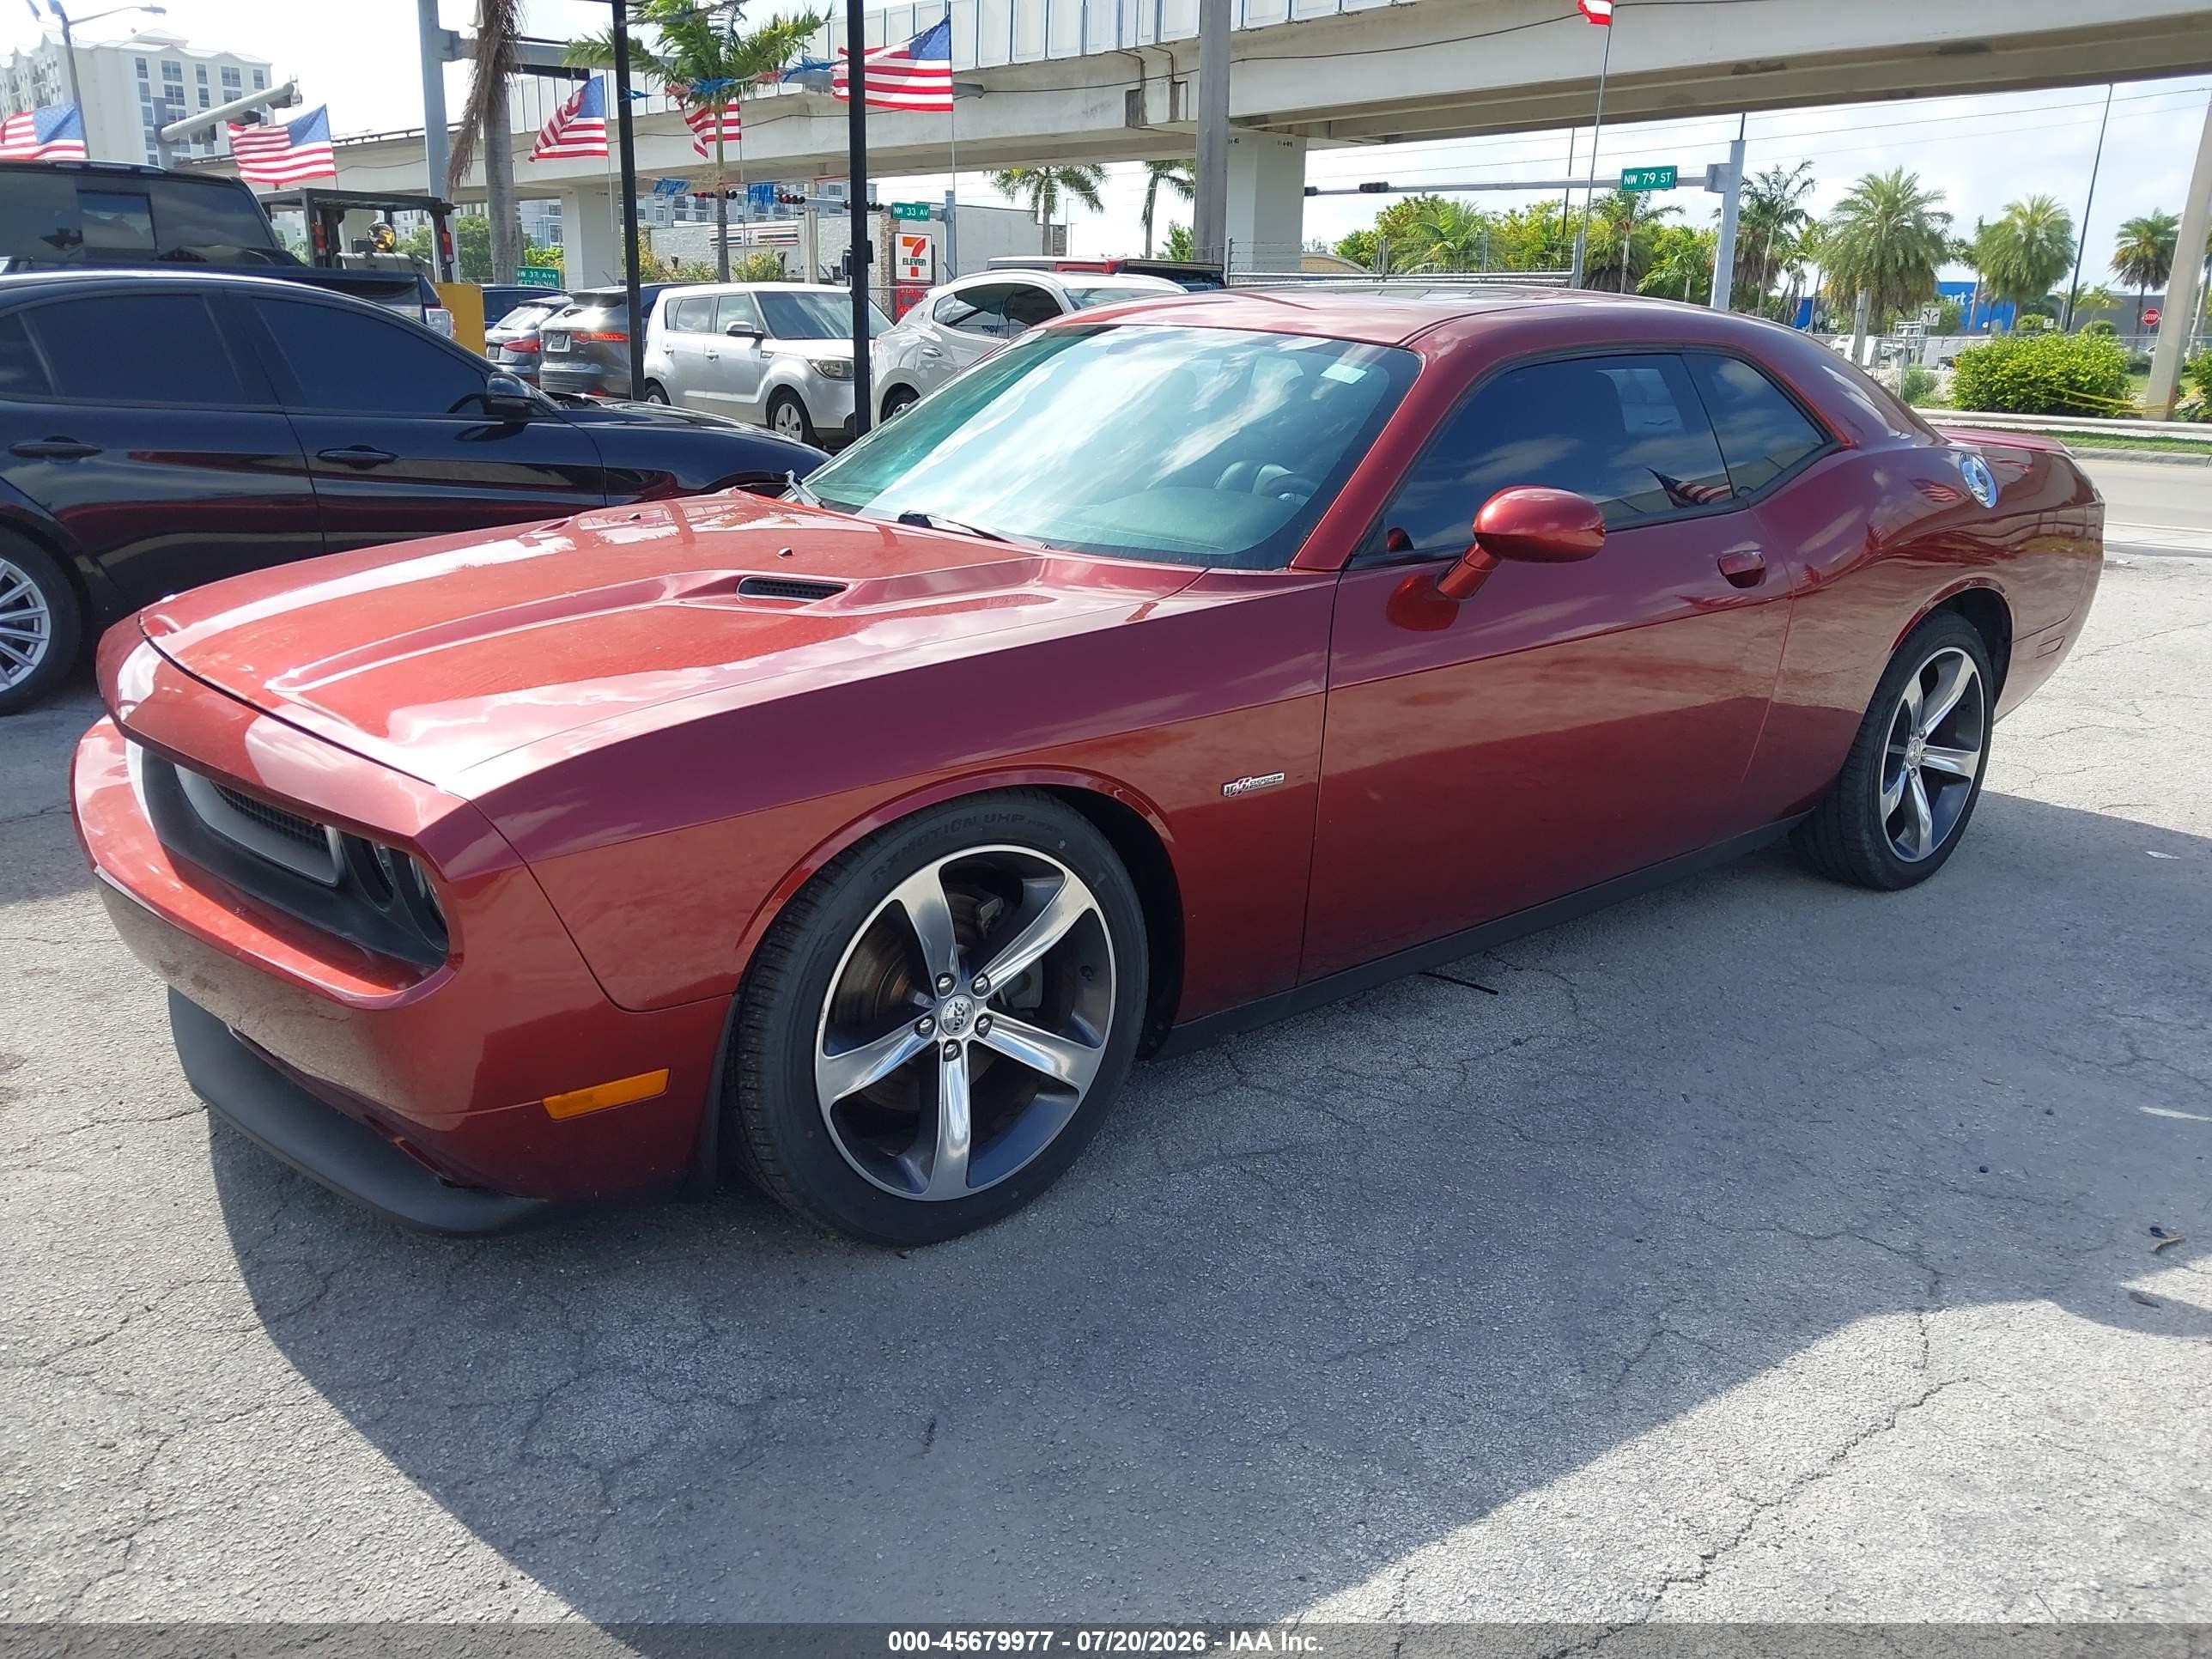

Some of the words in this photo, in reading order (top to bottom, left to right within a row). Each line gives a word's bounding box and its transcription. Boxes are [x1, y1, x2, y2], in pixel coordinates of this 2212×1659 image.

[1624, 174, 1638, 185] NW
[1643, 173, 1656, 185] 79
[1660, 172, 1672, 183] ST
[906, 208, 916, 216] 33
